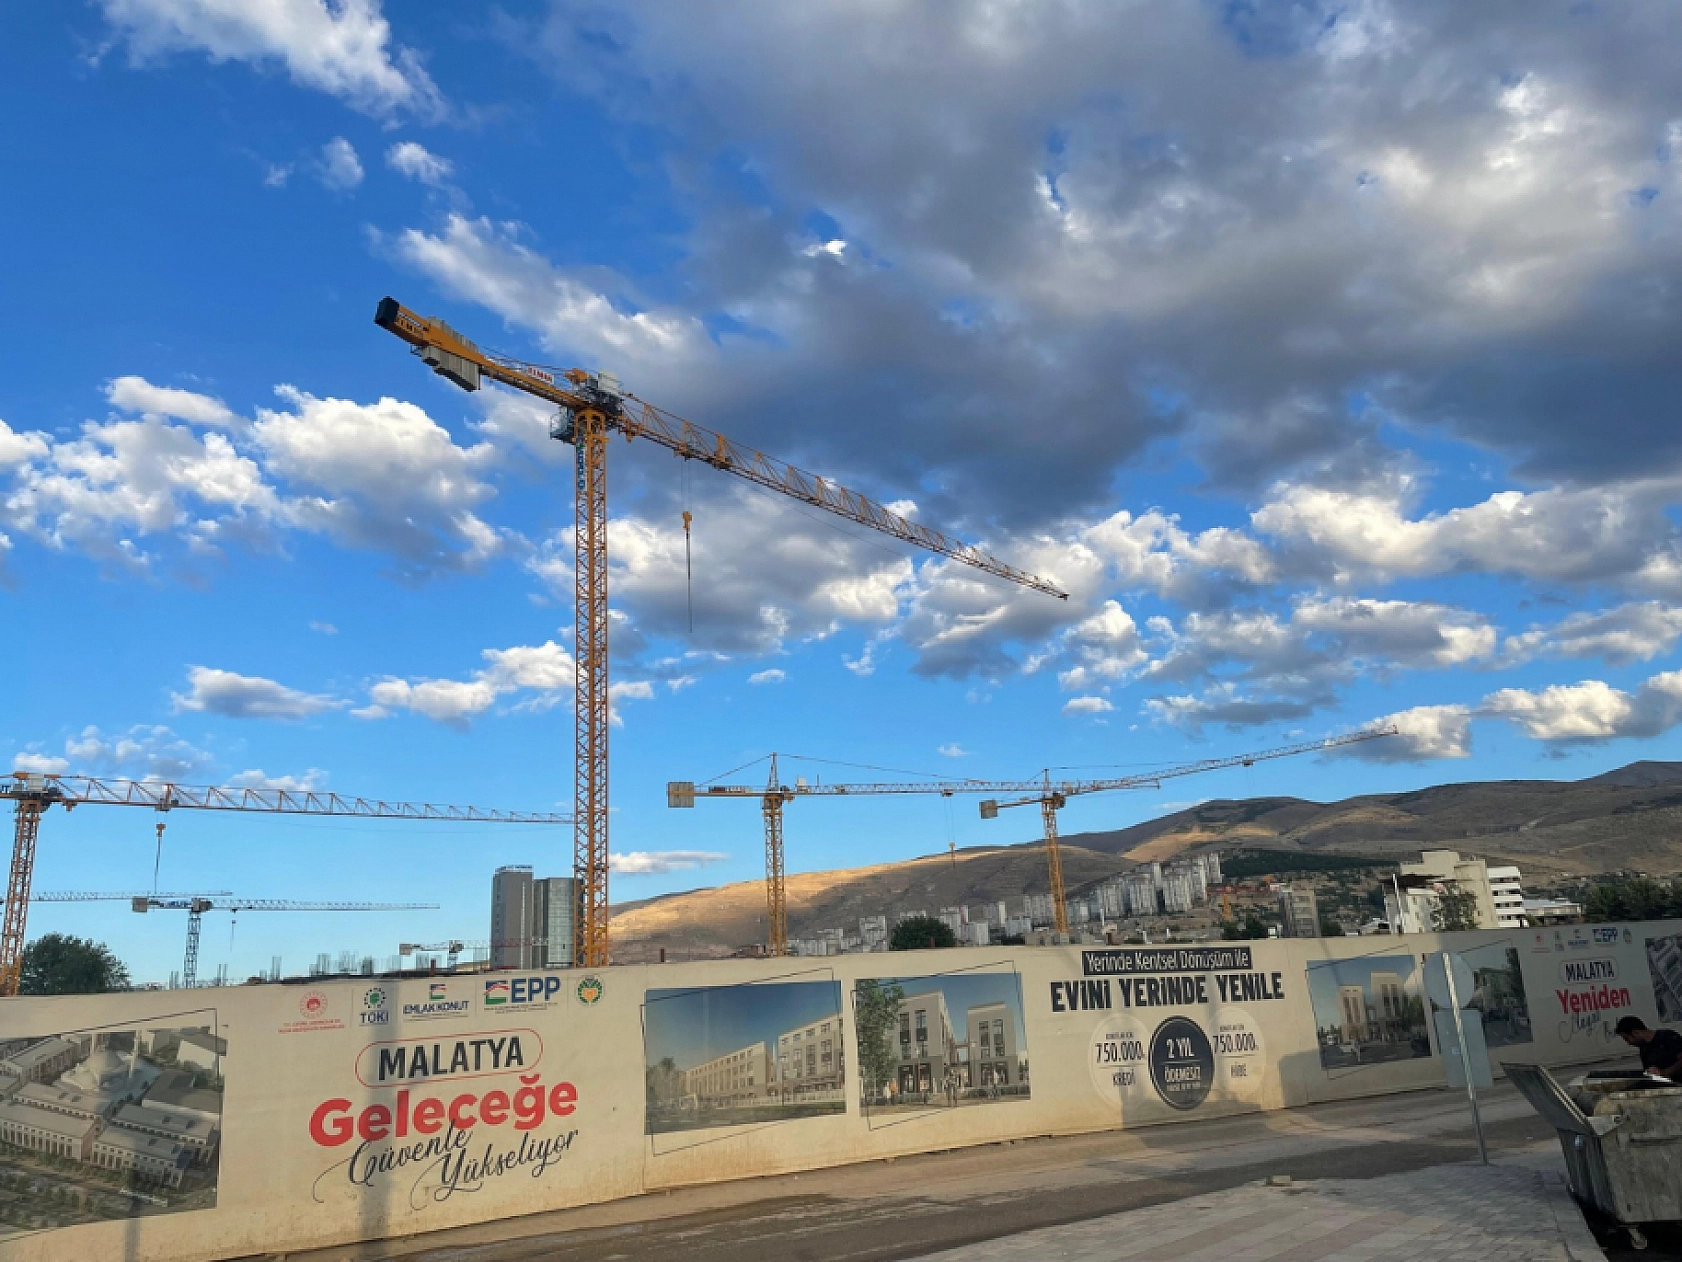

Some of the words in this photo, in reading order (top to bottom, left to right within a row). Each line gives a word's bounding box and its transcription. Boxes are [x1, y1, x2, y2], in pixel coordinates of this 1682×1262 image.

[1085, 952, 1133, 972] Yerinde
[1135, 950, 1178, 971] Kentsel
[1179, 950, 1233, 970] Dönüşüm
[1565, 960, 1615, 981] MALATYA
[511, 977, 561, 1003] EPP
[1555, 984, 1631, 1014] Yeniden
[403, 1003, 435, 1014] EMLAK
[437, 1000, 469, 1011] KONUT
[378, 1036, 523, 1081] MALATYA
[1166, 1038, 1175, 1058] 2
[308, 1073, 578, 1147] Geleceğe
[312, 1118, 474, 1203] Güvenle
[410, 1128, 579, 1210] Yükseliyor
